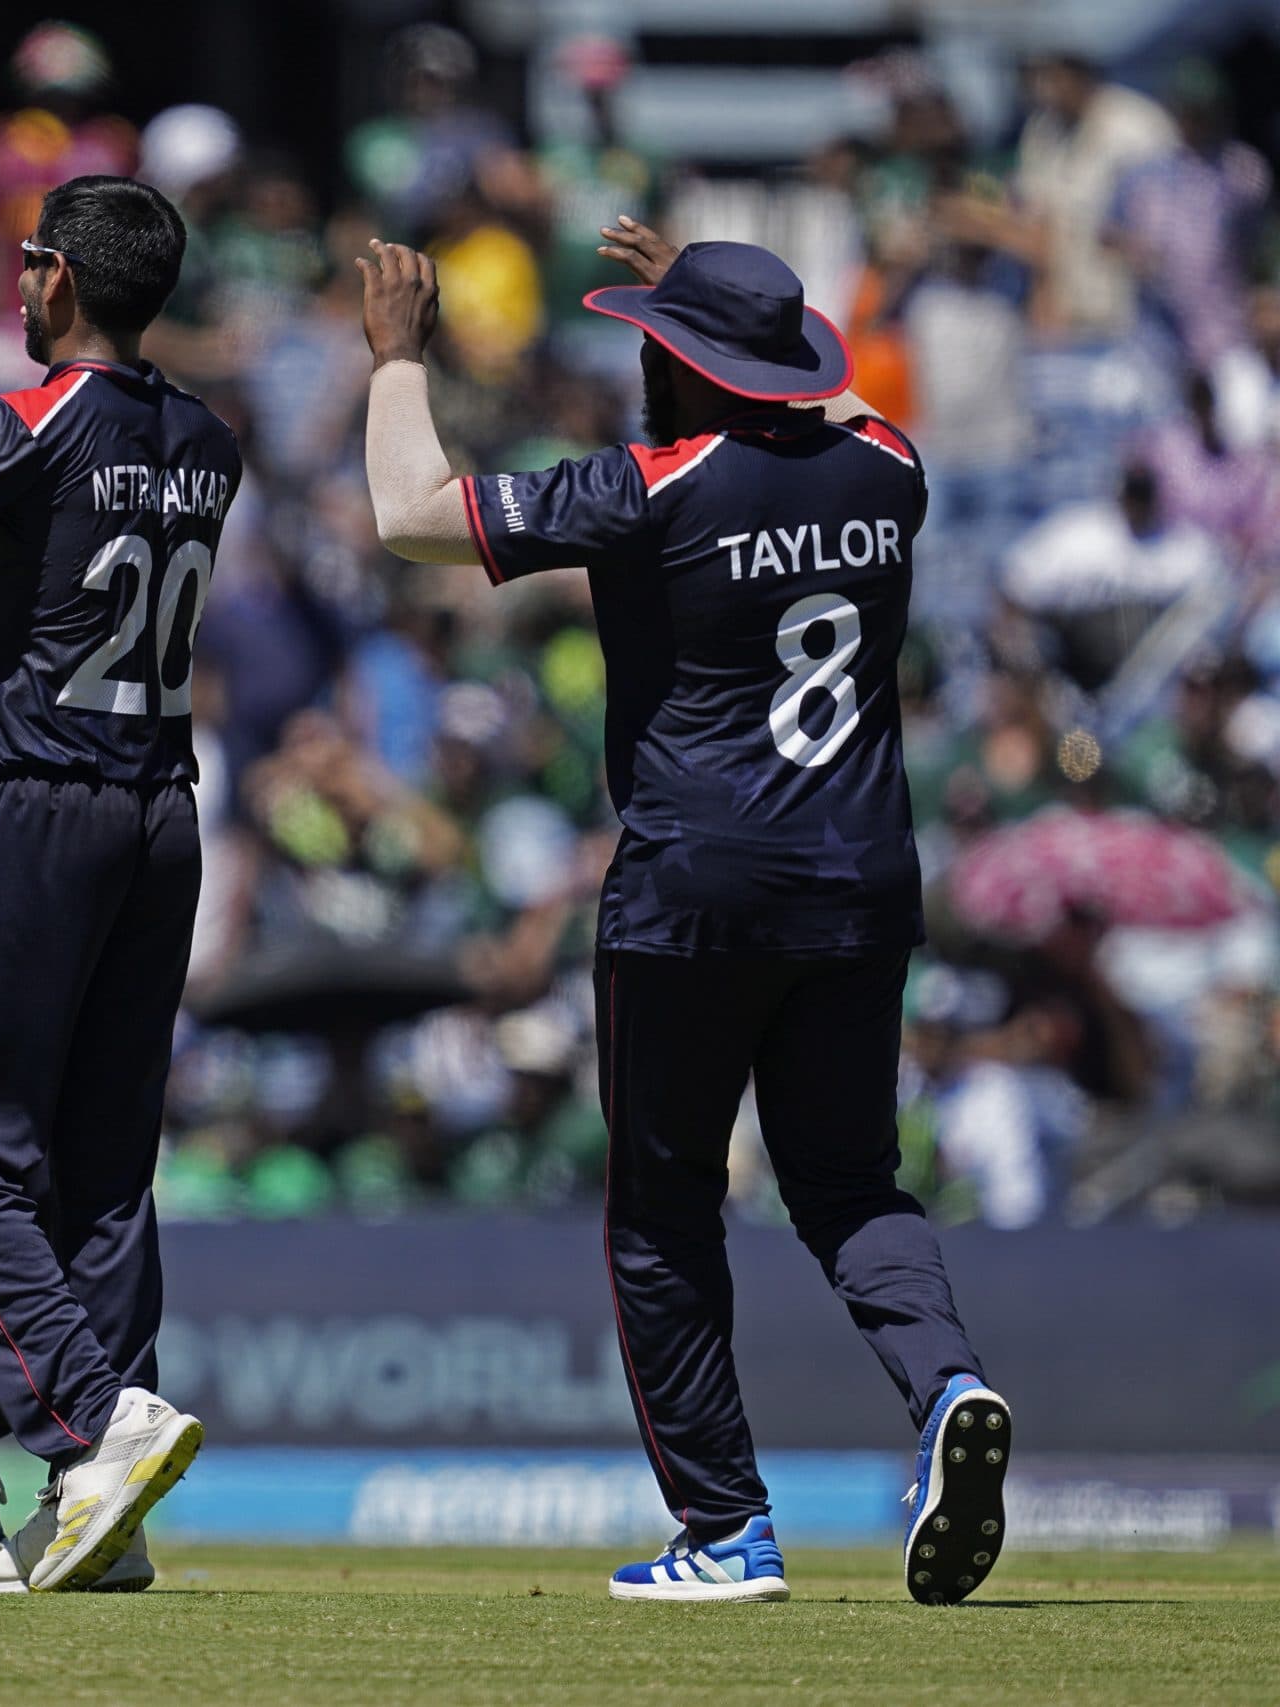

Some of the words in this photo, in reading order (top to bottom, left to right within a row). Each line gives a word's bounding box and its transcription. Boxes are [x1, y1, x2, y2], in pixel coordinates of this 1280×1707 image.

[717, 519, 902, 580] TAYLOR
[56, 534, 213, 717] 20
[769, 593, 862, 768] 8
[217, 1310, 635, 1428] WORL
